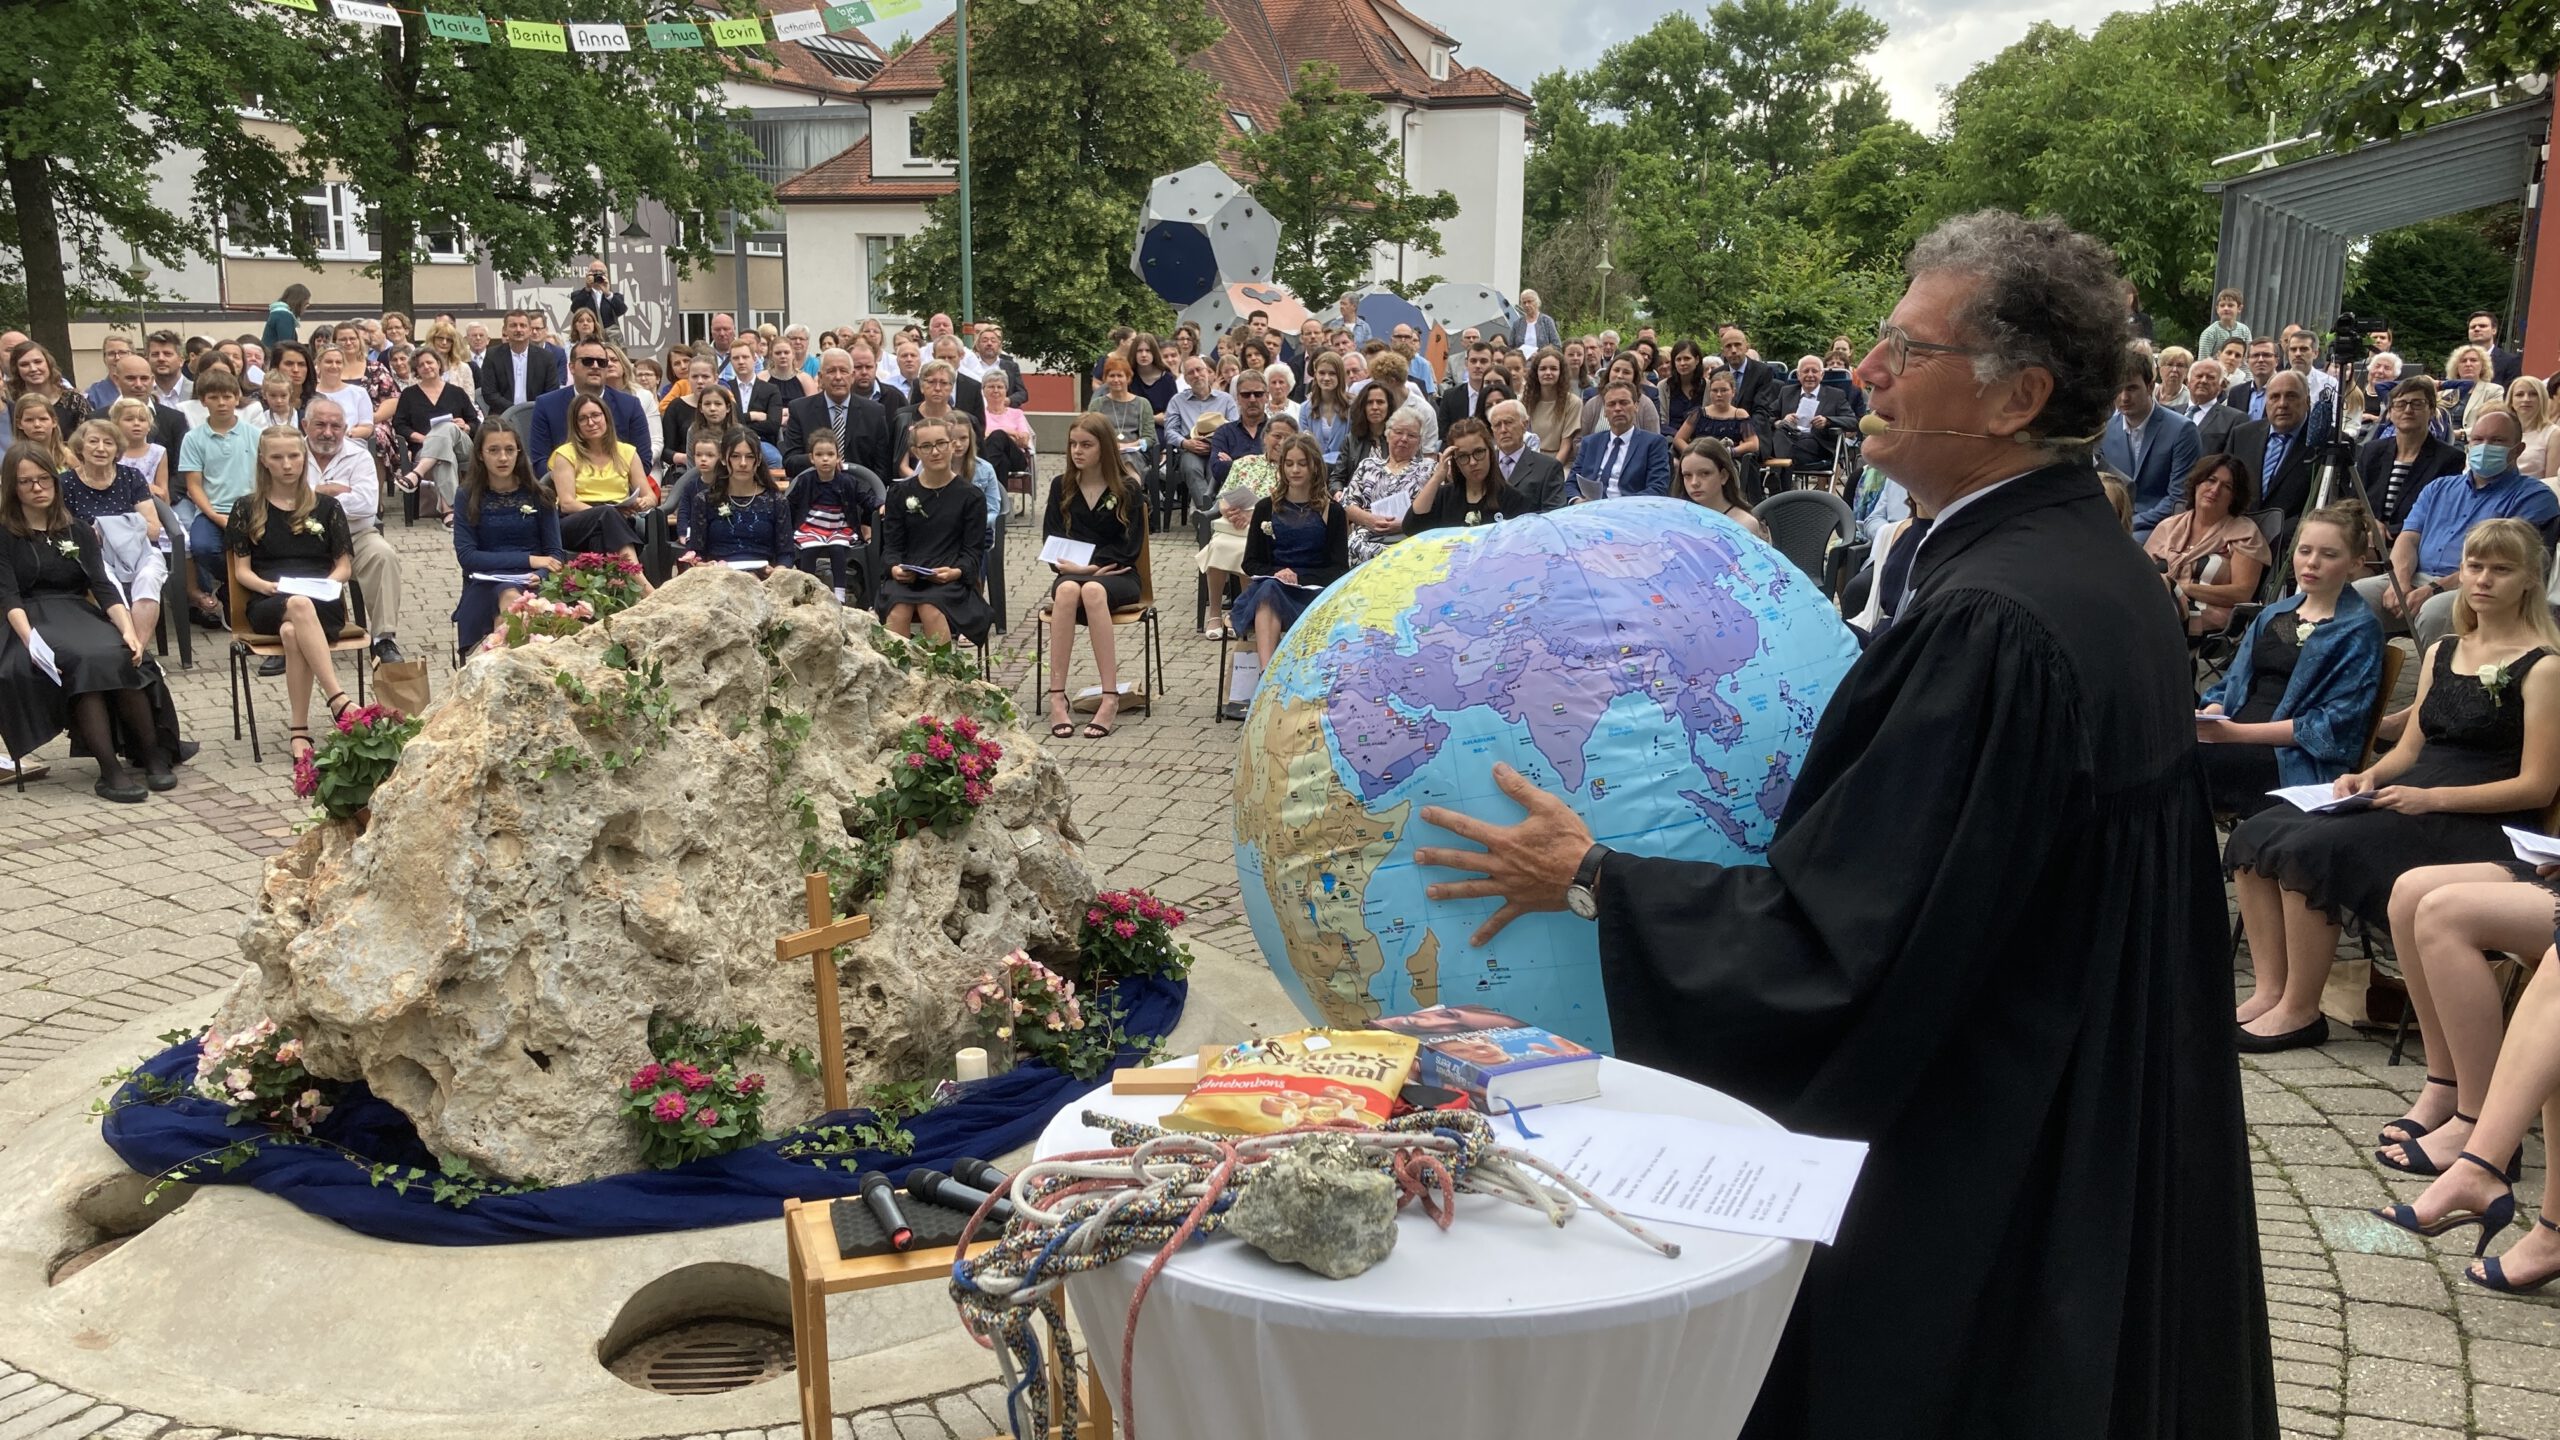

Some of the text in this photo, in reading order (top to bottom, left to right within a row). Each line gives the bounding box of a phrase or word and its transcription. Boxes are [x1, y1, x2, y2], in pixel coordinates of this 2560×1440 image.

[337, 3, 397, 21] Florian
[431, 17, 483, 36] Maike
[718, 24, 758, 40] Levin
[776, 20, 822, 35] Katharina
[511, 28, 562, 45] Benita
[578, 30, 625, 47] Anna
